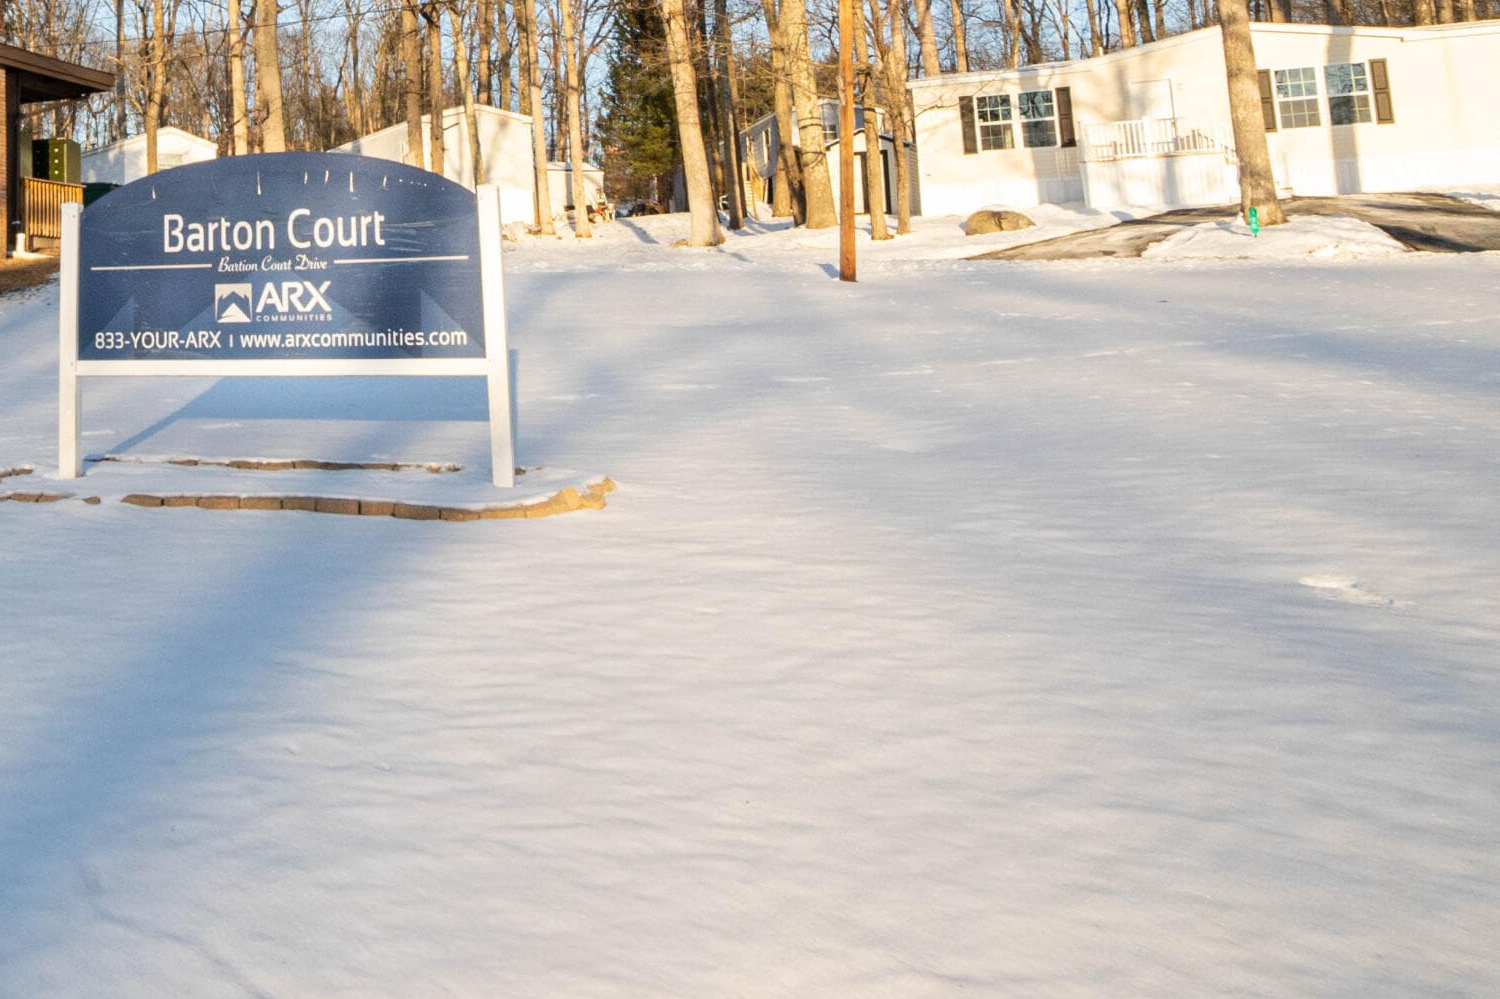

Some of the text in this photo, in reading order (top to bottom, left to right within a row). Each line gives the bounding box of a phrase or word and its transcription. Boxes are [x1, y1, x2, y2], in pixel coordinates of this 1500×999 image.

[163, 207, 386, 253] Barton Court
[261, 254, 292, 272] Court
[293, 253, 328, 271] Drive
[255, 280, 333, 313] ARX
[255, 313, 333, 323] COMMUNITIES
[94, 330, 221, 350] 833-YOUR-ARX
[240, 328, 468, 347] www.arxcommunities.com
